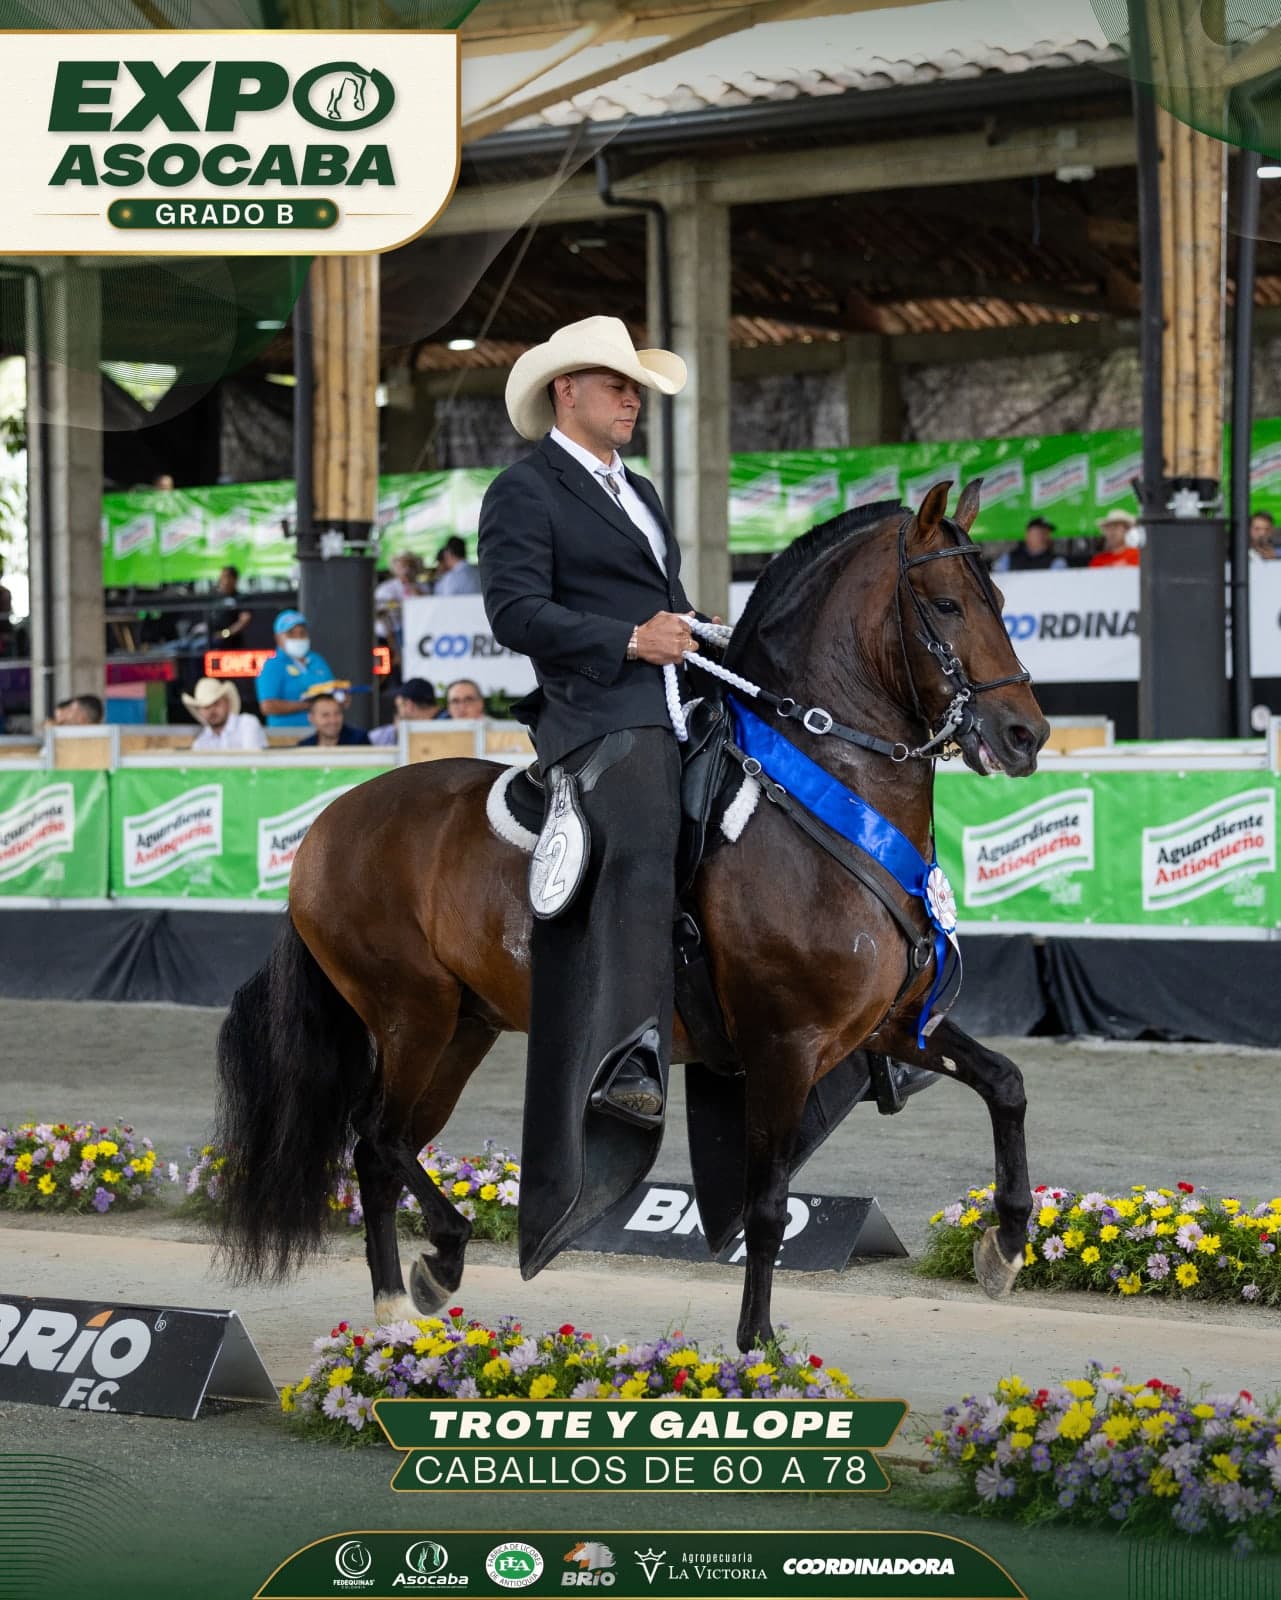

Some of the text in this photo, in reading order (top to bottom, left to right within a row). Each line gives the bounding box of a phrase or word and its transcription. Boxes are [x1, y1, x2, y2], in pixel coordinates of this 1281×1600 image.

[1001, 610, 1139, 640] OORDINA
[977, 814, 1079, 862] Aguardiente
[1155, 832, 1265, 886] Antioqueño
[1157, 814, 1263, 864] Aguardiente
[542, 832, 567, 900] 2
[59, 1377, 120, 1412] F.C.
